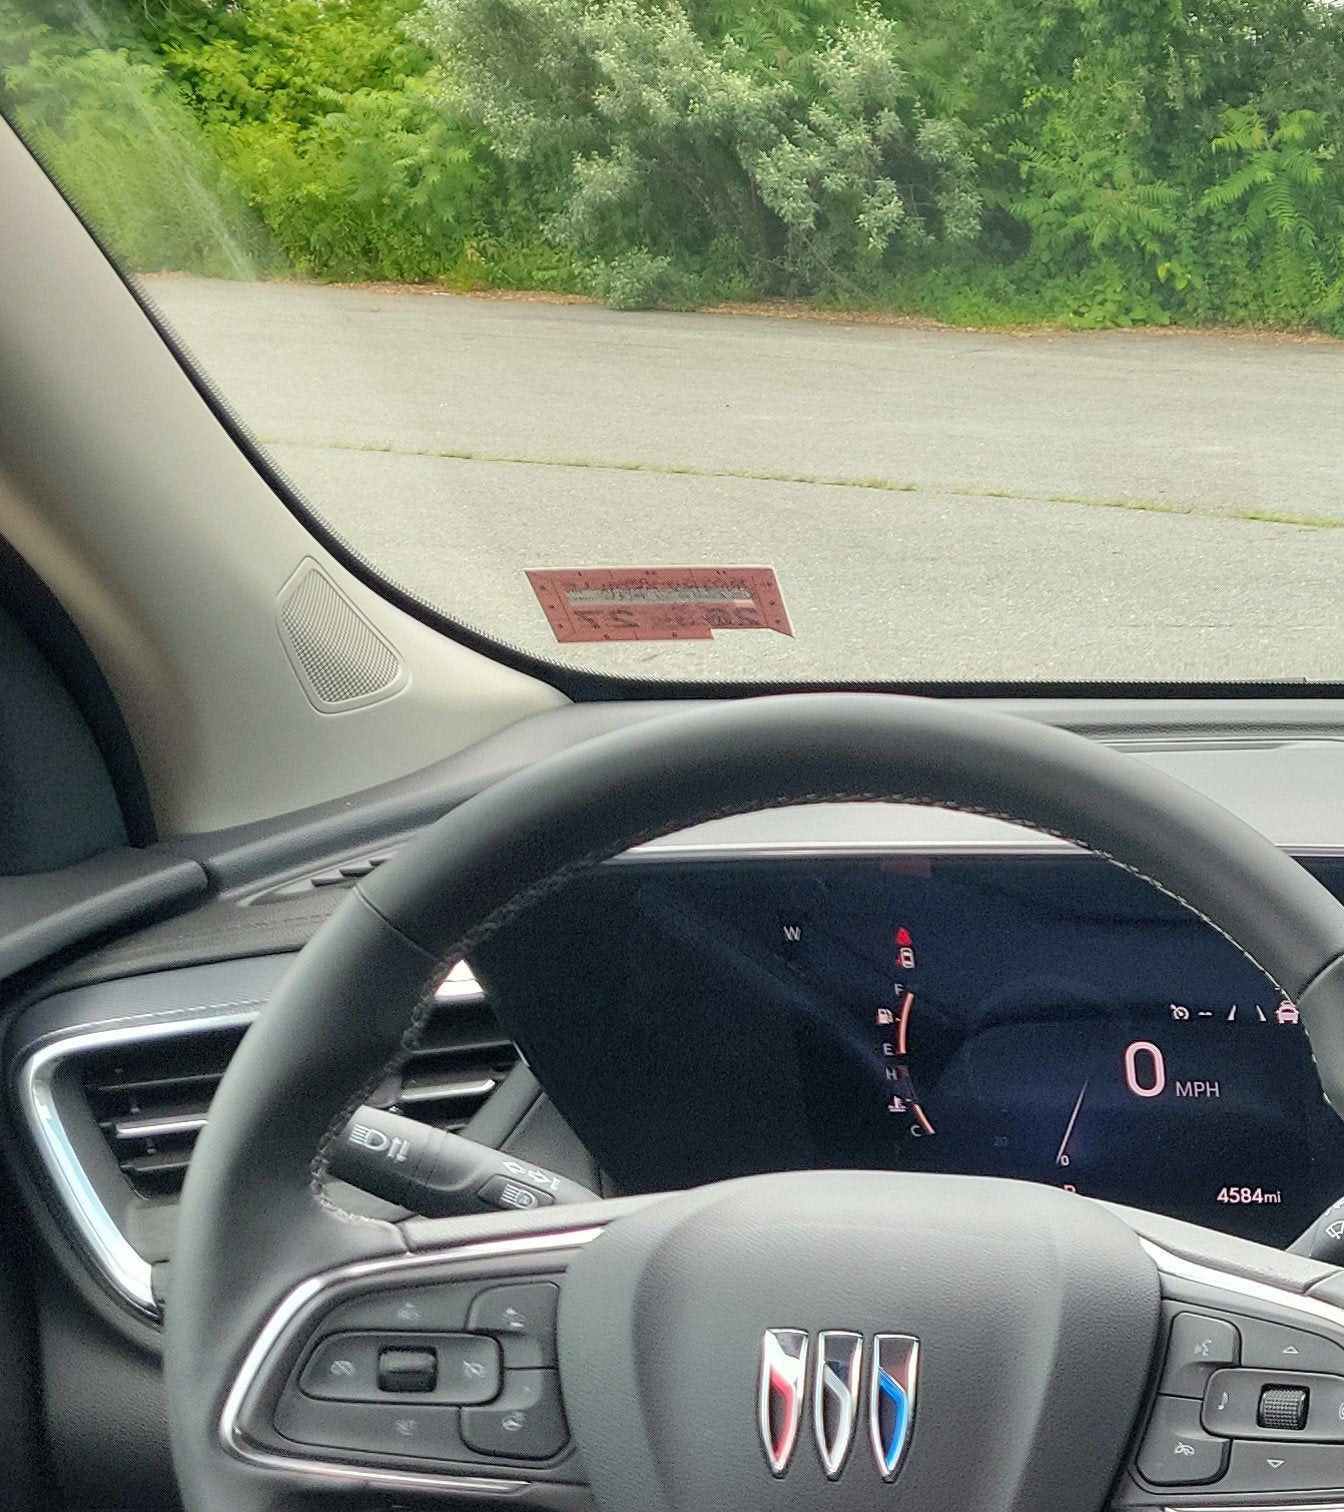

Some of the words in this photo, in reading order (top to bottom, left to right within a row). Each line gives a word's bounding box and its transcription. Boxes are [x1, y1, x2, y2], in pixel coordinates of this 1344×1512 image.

[783, 926, 801, 941] W
[894, 983, 903, 996] F
[883, 1042, 894, 1056] E
[885, 1068, 897, 1081] H
[1124, 1041, 1165, 1097] 0
[1175, 1081, 1221, 1098] MPH
